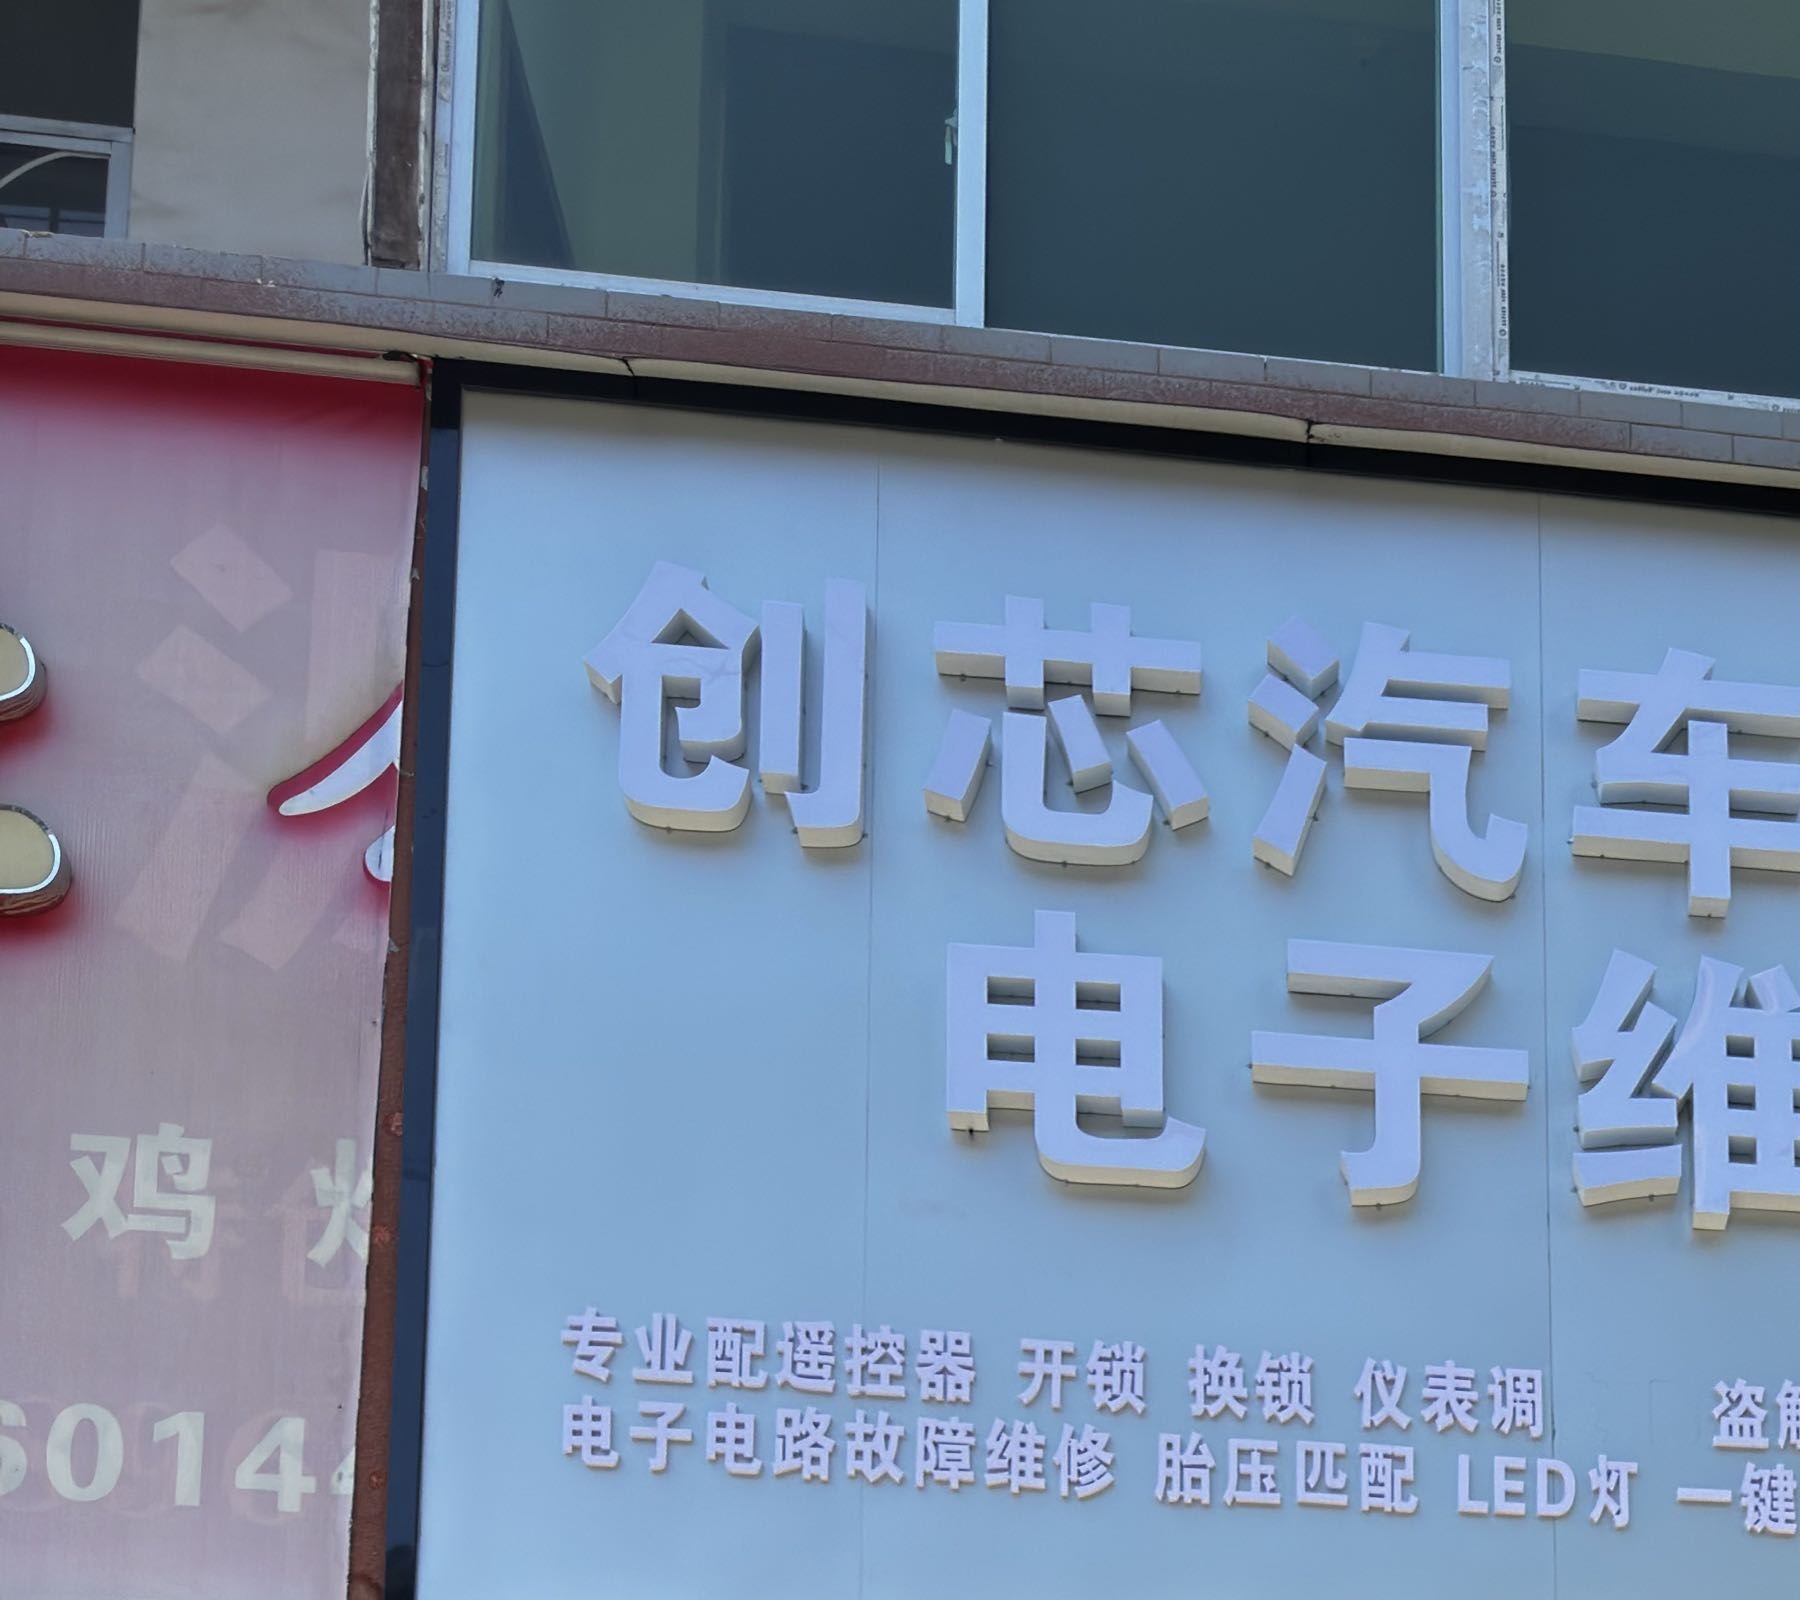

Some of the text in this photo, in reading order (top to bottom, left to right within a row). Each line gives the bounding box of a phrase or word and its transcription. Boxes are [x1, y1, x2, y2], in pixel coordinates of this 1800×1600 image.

[560, 1306, 977, 1404] 专业配遥控器
[1017, 1337, 1148, 1416] 开锁
[1188, 1343, 1316, 1426] 换锁
[1353, 1356, 1545, 1440] 仪表调
[562, 1394, 1117, 1501] 电子电路故障维修
[1155, 1431, 1419, 1516] 胎压匹配
[1456, 1452, 1639, 1529] LED灯
